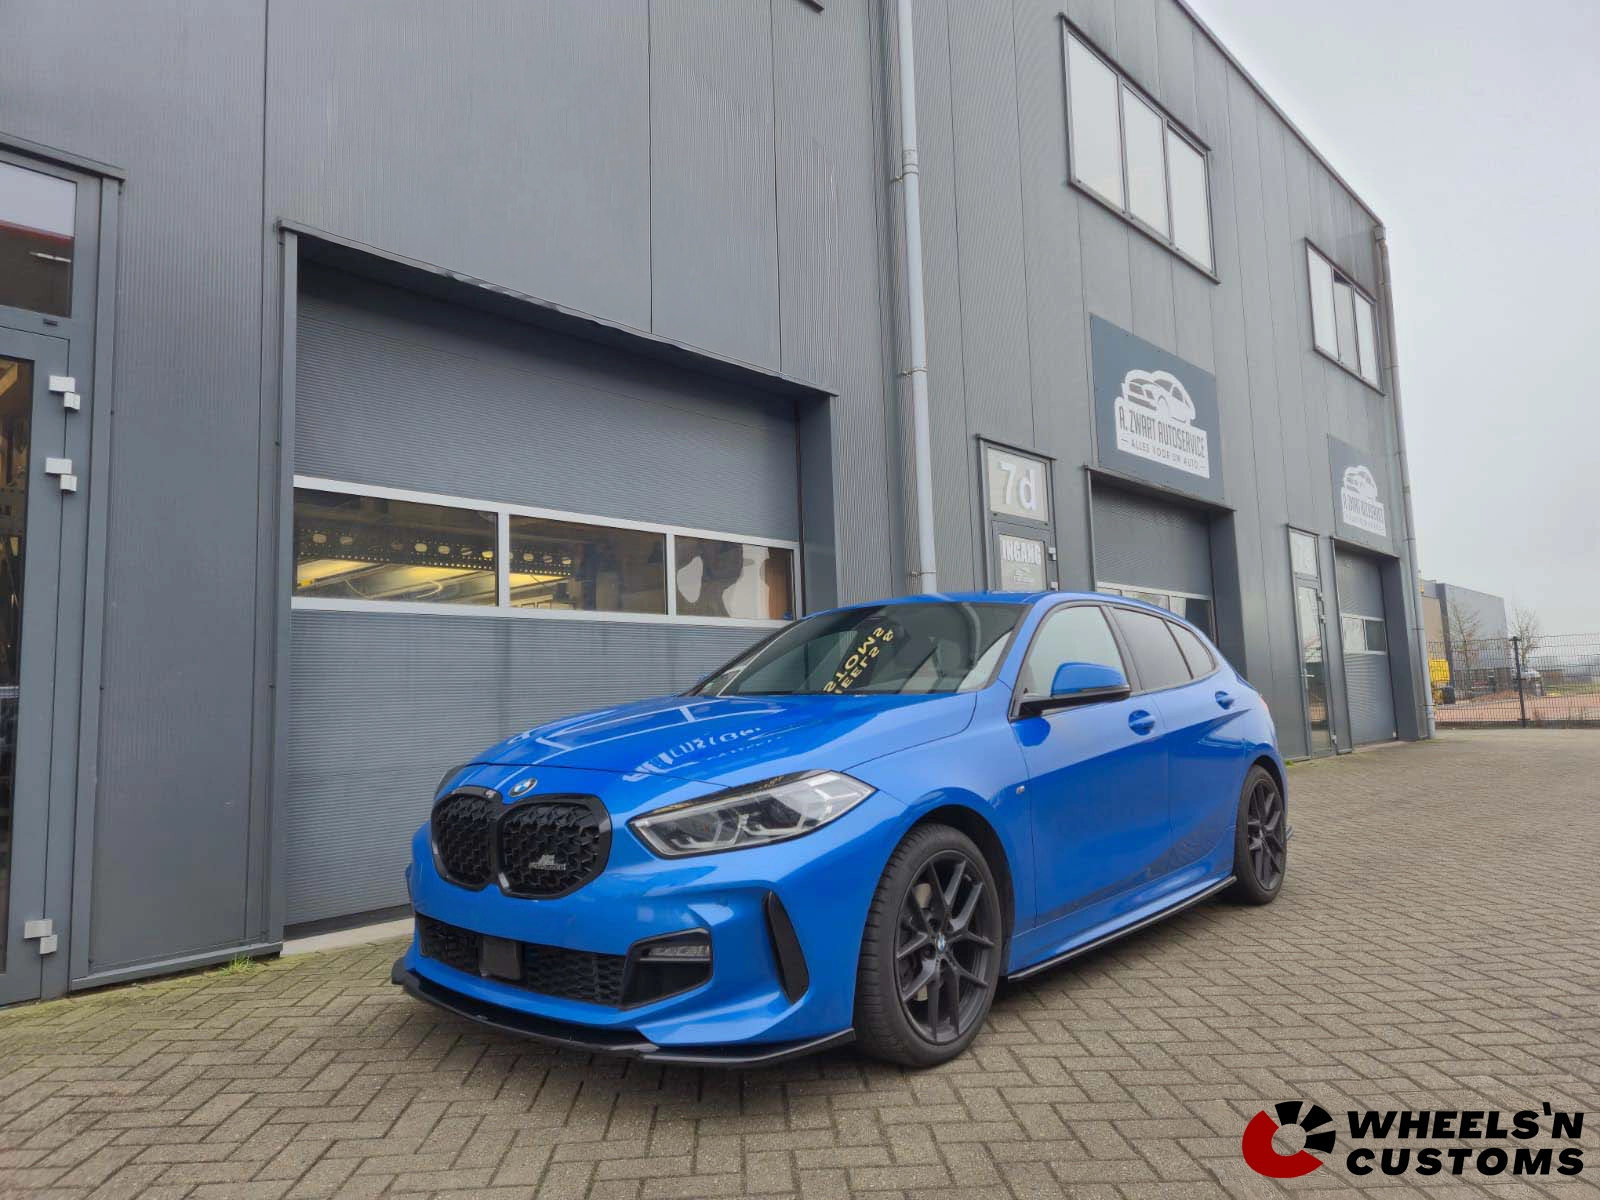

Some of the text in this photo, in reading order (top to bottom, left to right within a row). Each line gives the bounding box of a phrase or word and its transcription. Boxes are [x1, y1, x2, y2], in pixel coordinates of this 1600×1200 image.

[1129, 409, 1156, 441] ZWART
[1158, 421, 1206, 458] AUTOSERVICE
[1000, 462, 1036, 511] 7d
[1002, 539, 1041, 566] INGANG
